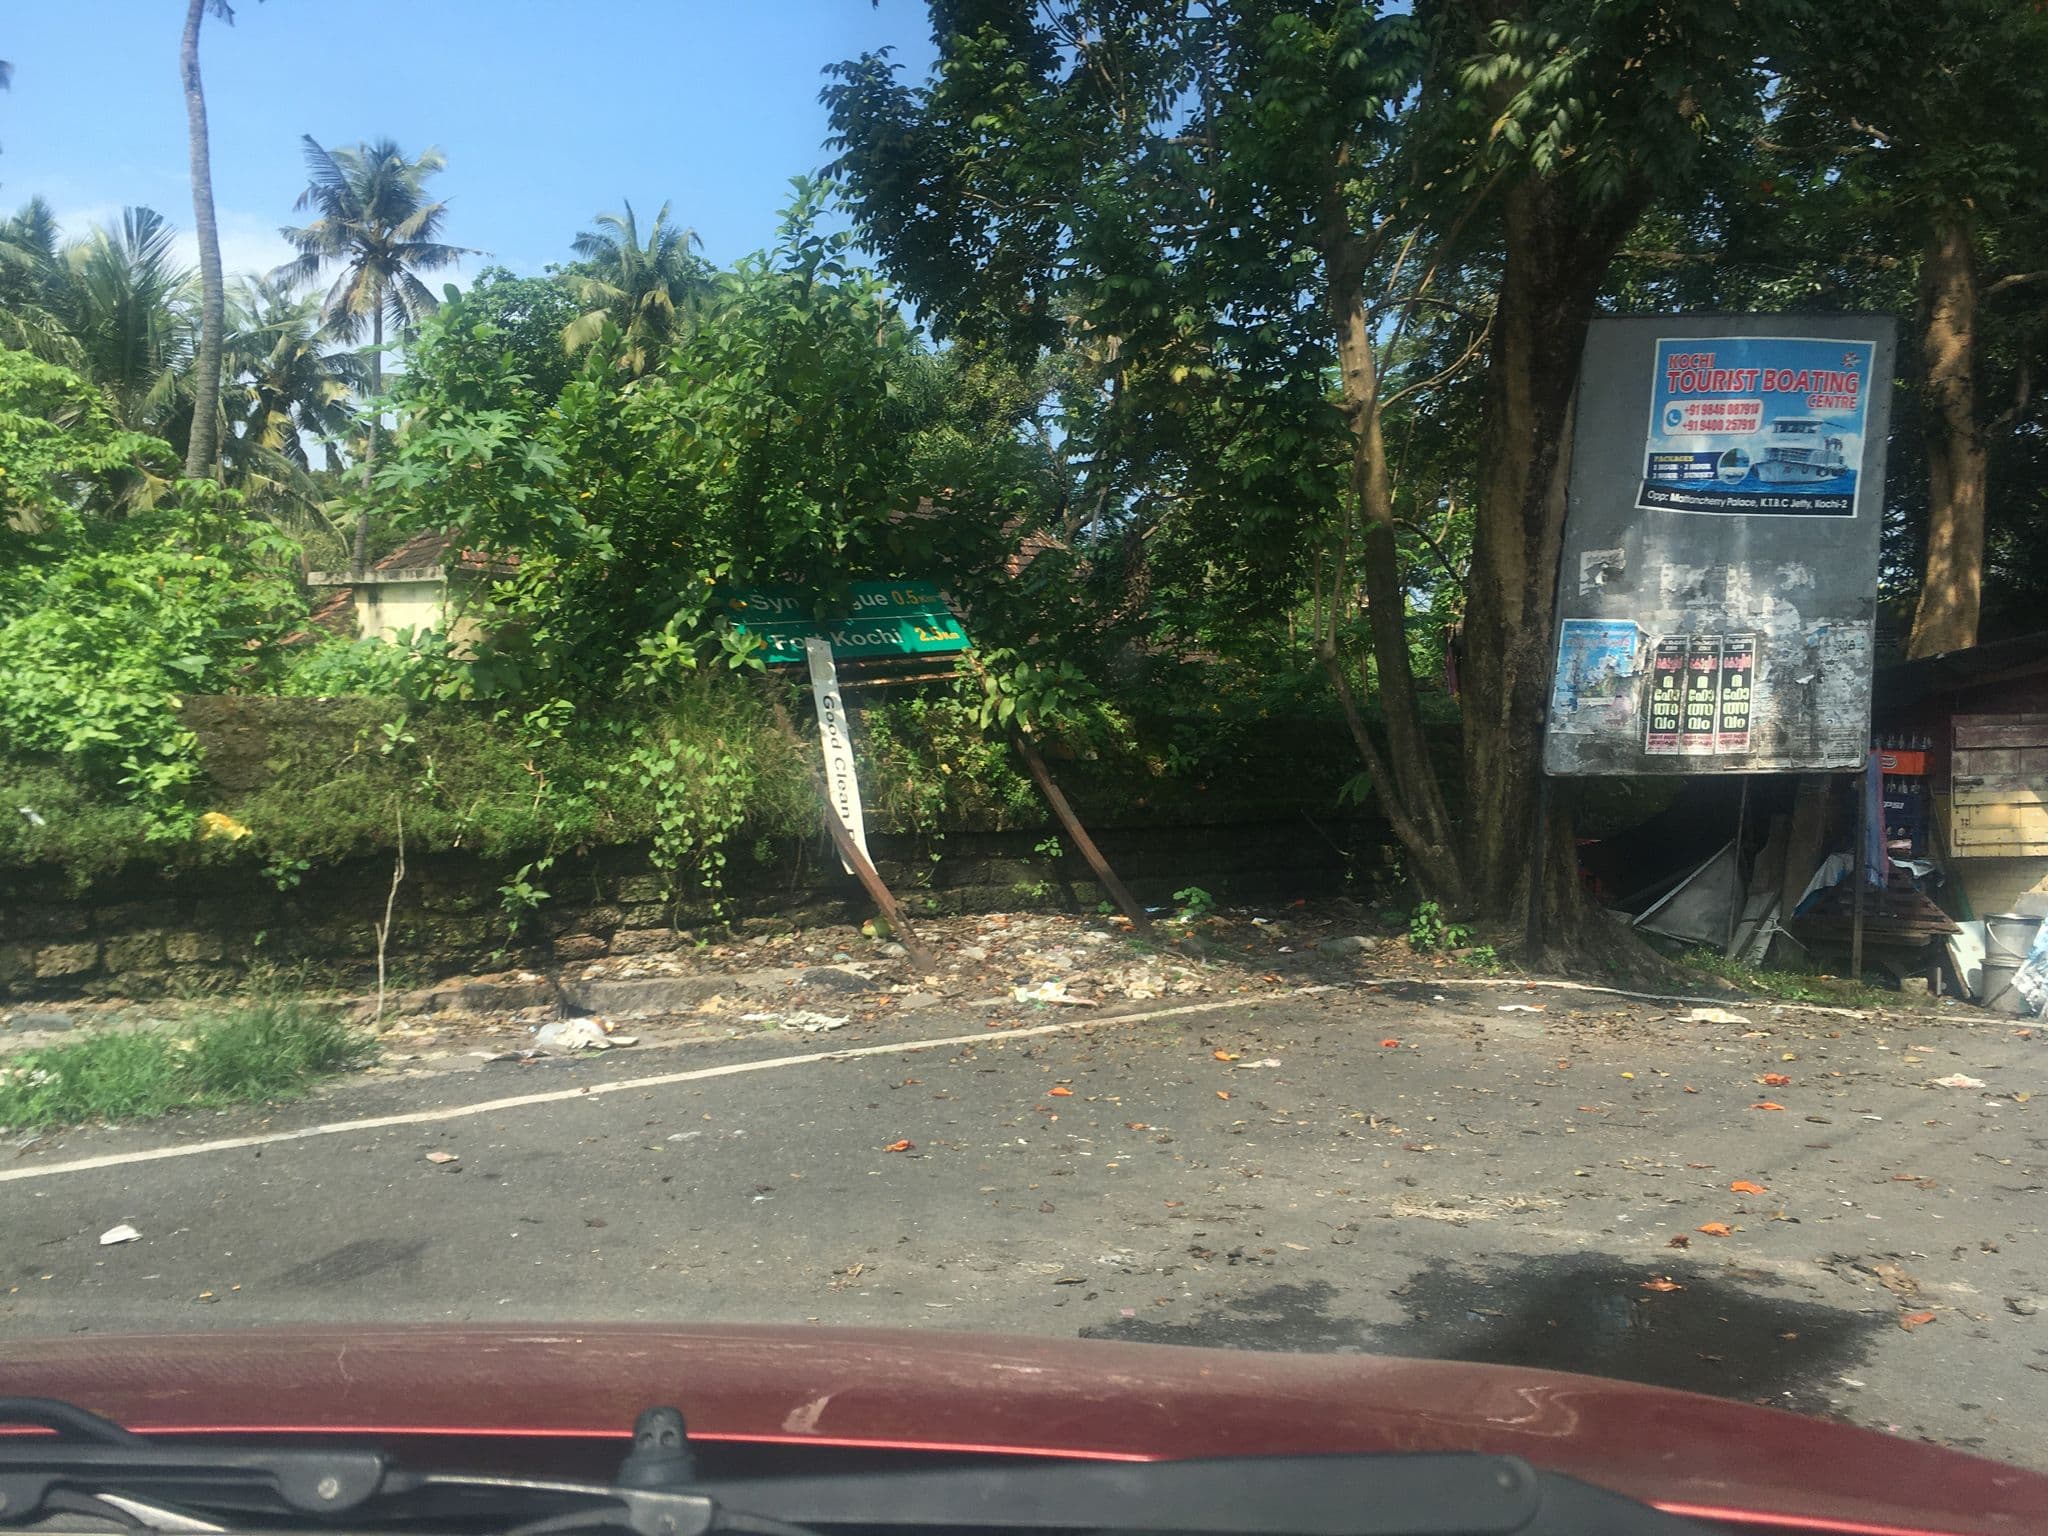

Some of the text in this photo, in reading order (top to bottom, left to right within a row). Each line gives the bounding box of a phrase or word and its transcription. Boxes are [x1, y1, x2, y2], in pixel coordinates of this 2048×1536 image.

[1667, 352, 1716, 369] KOCHI
[1667, 368, 1860, 394] TOURIST BOATING
[1807, 395, 1858, 409] CENTRE
[1684, 404, 1700, 416] +91
[1682, 419, 1698, 431] +91
[829, 628, 905, 647] Kochi
[822, 695, 843, 750] Good
[833, 757, 851, 819] Clean
[1883, 800, 1905, 810] PSI
